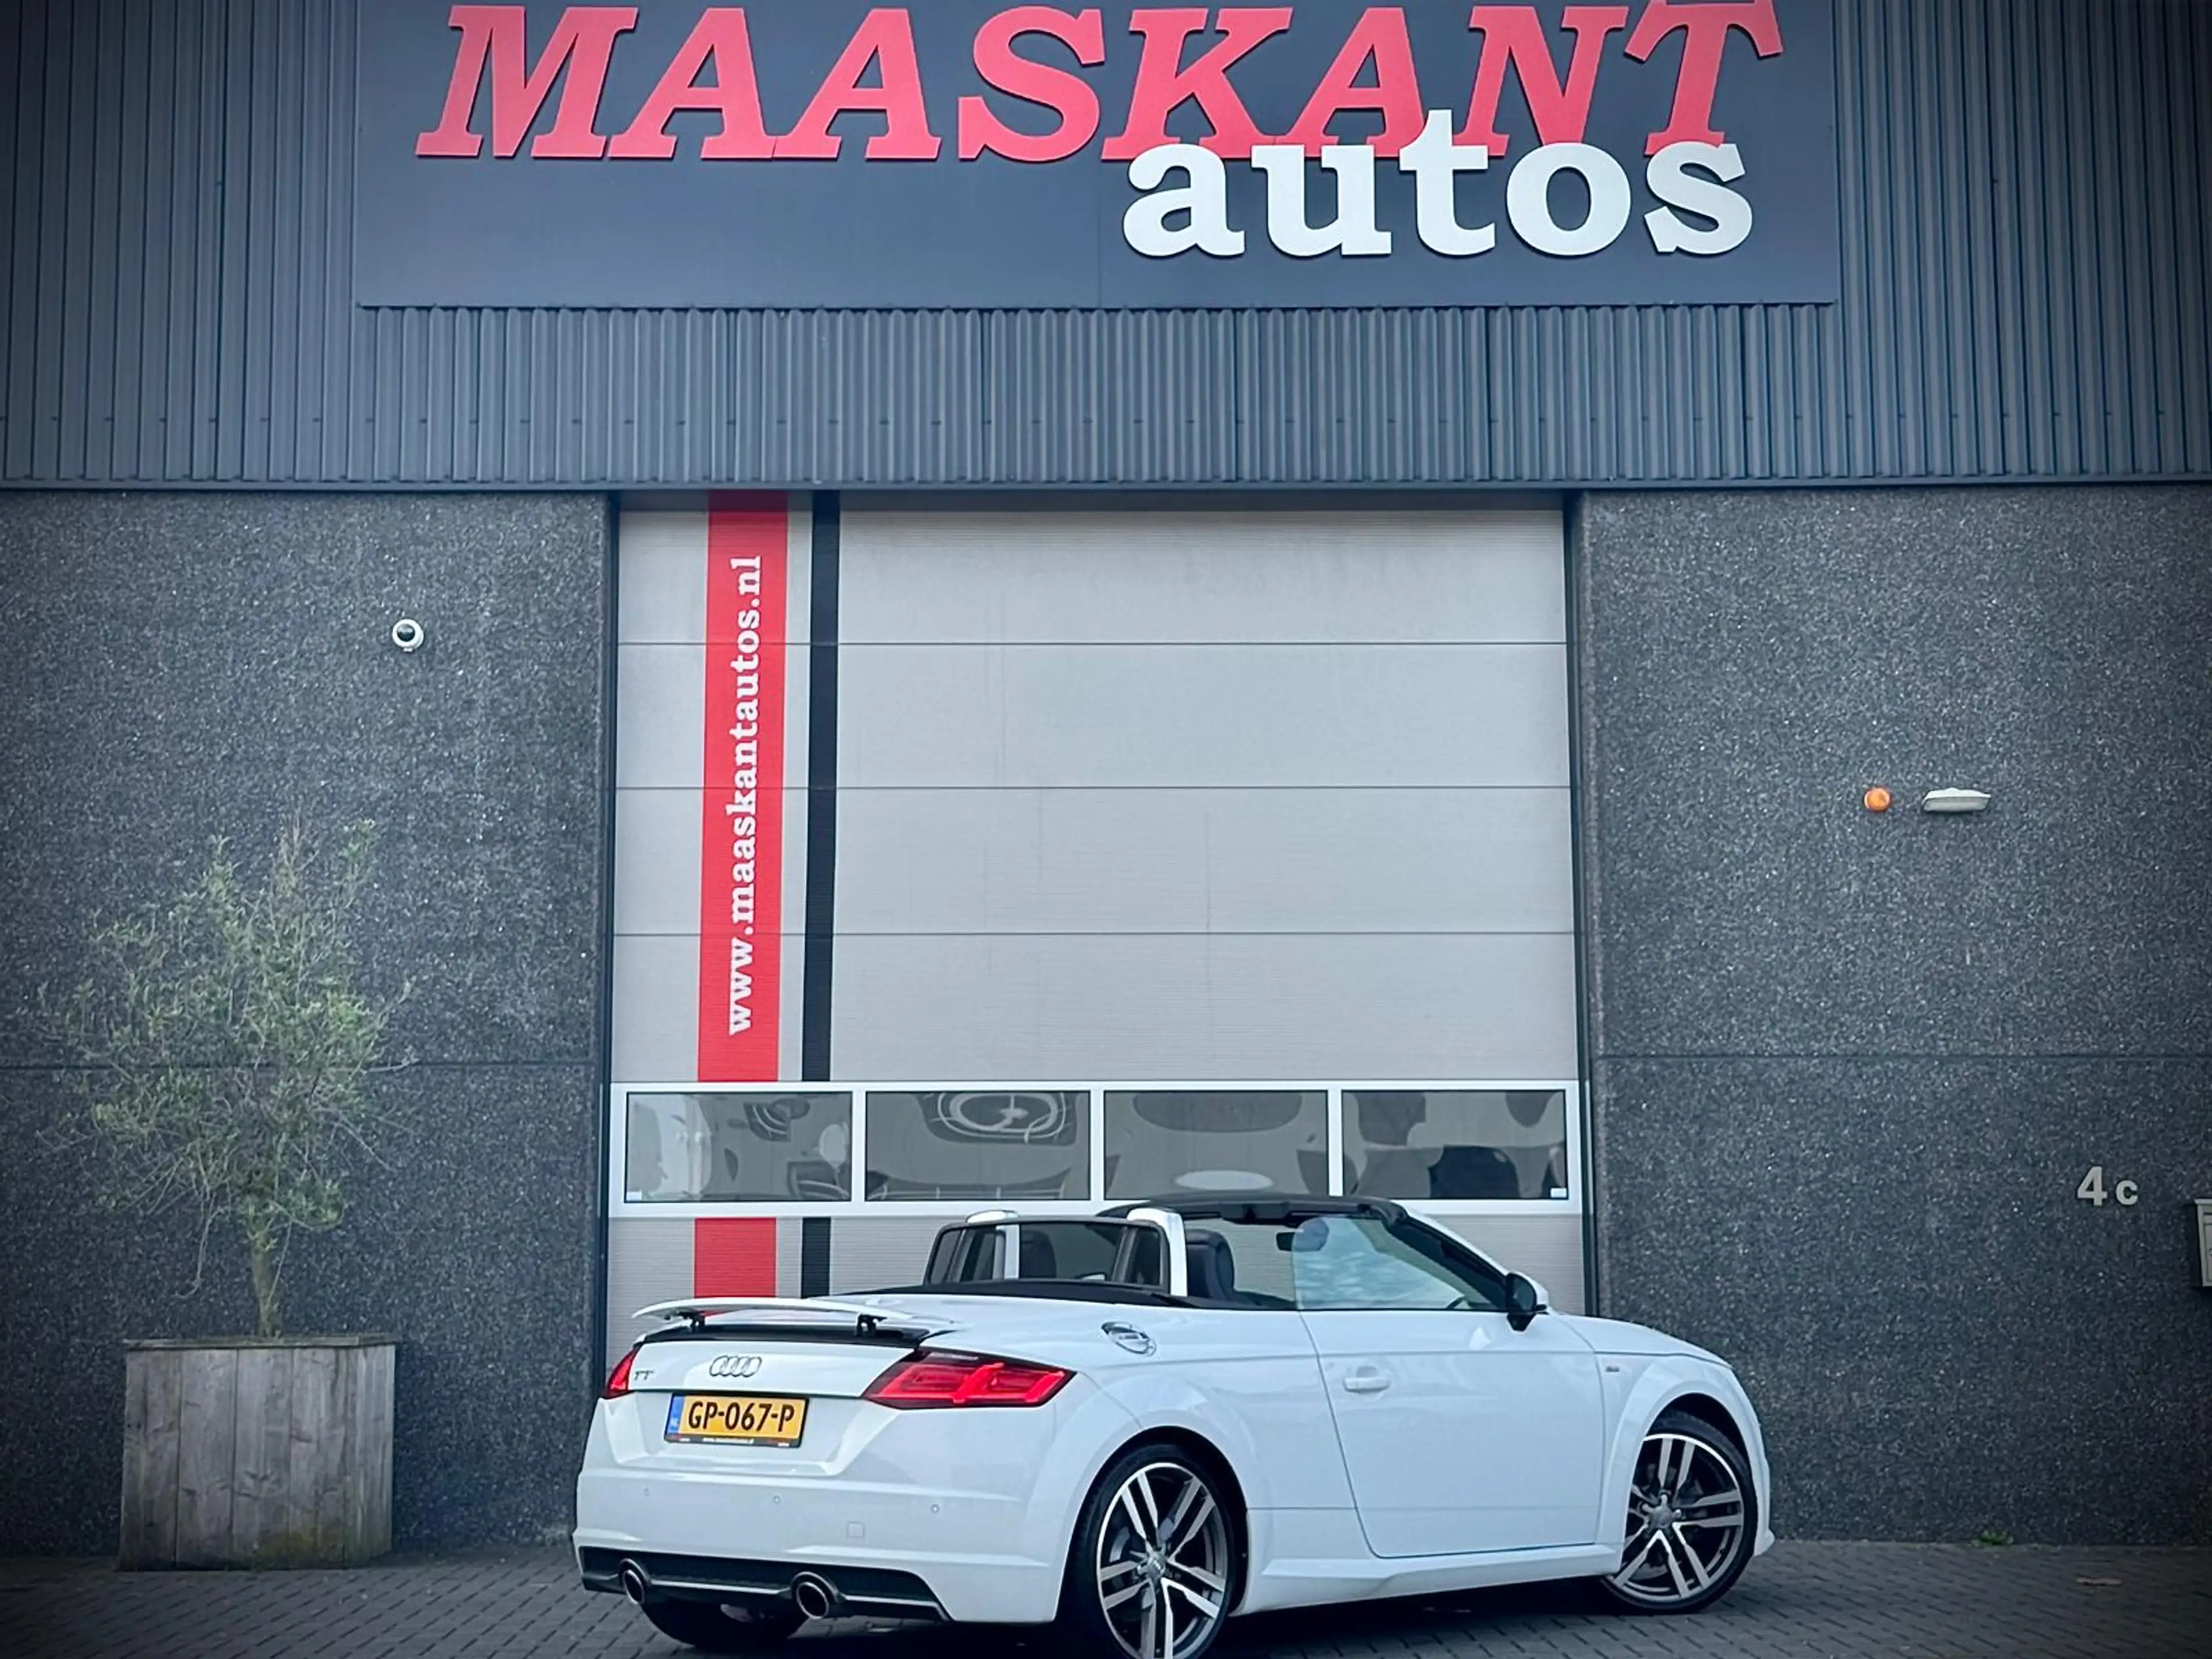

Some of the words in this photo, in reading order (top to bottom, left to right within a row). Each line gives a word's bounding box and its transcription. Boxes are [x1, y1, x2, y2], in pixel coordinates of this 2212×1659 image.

[415, 0, 1784, 161] MAASKANT
[1123, 109, 1753, 256] autos
[725, 555, 761, 1036] www.maaskantautos.nl
[688, 1400, 795, 1433] GP-067-P
